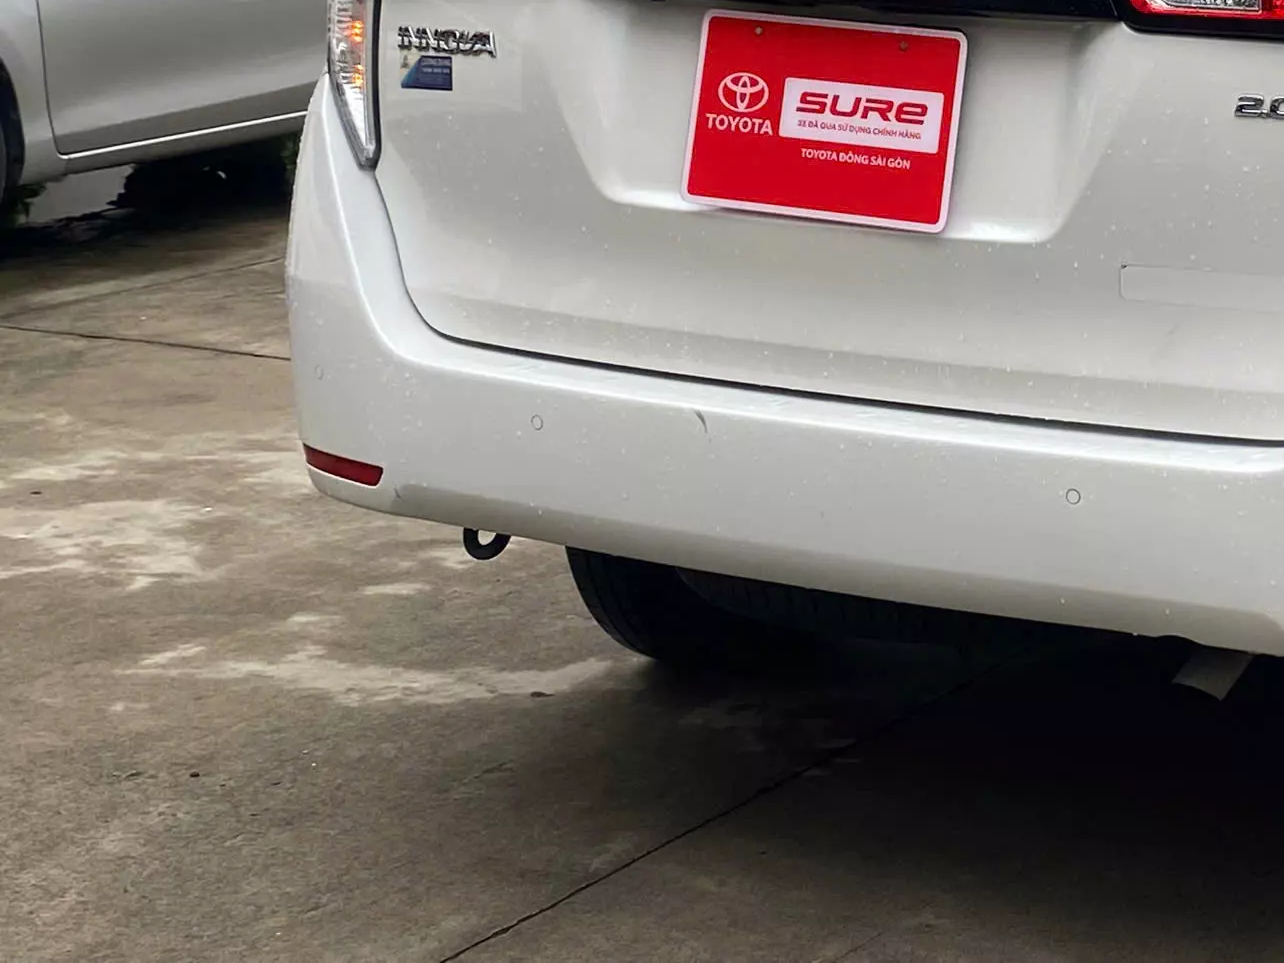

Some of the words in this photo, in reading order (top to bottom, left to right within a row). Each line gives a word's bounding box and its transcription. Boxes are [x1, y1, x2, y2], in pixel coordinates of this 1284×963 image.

[397, 24, 497, 58] INNOVA
[706, 113, 773, 136] TOYOTA
[820, 121, 836, 131] QUA
[801, 148, 837, 162] TOYOTA
[839, 151, 869, 166] ĐÔNG
[870, 154, 887, 167] SÀI
[887, 156, 911, 170] GÒN
